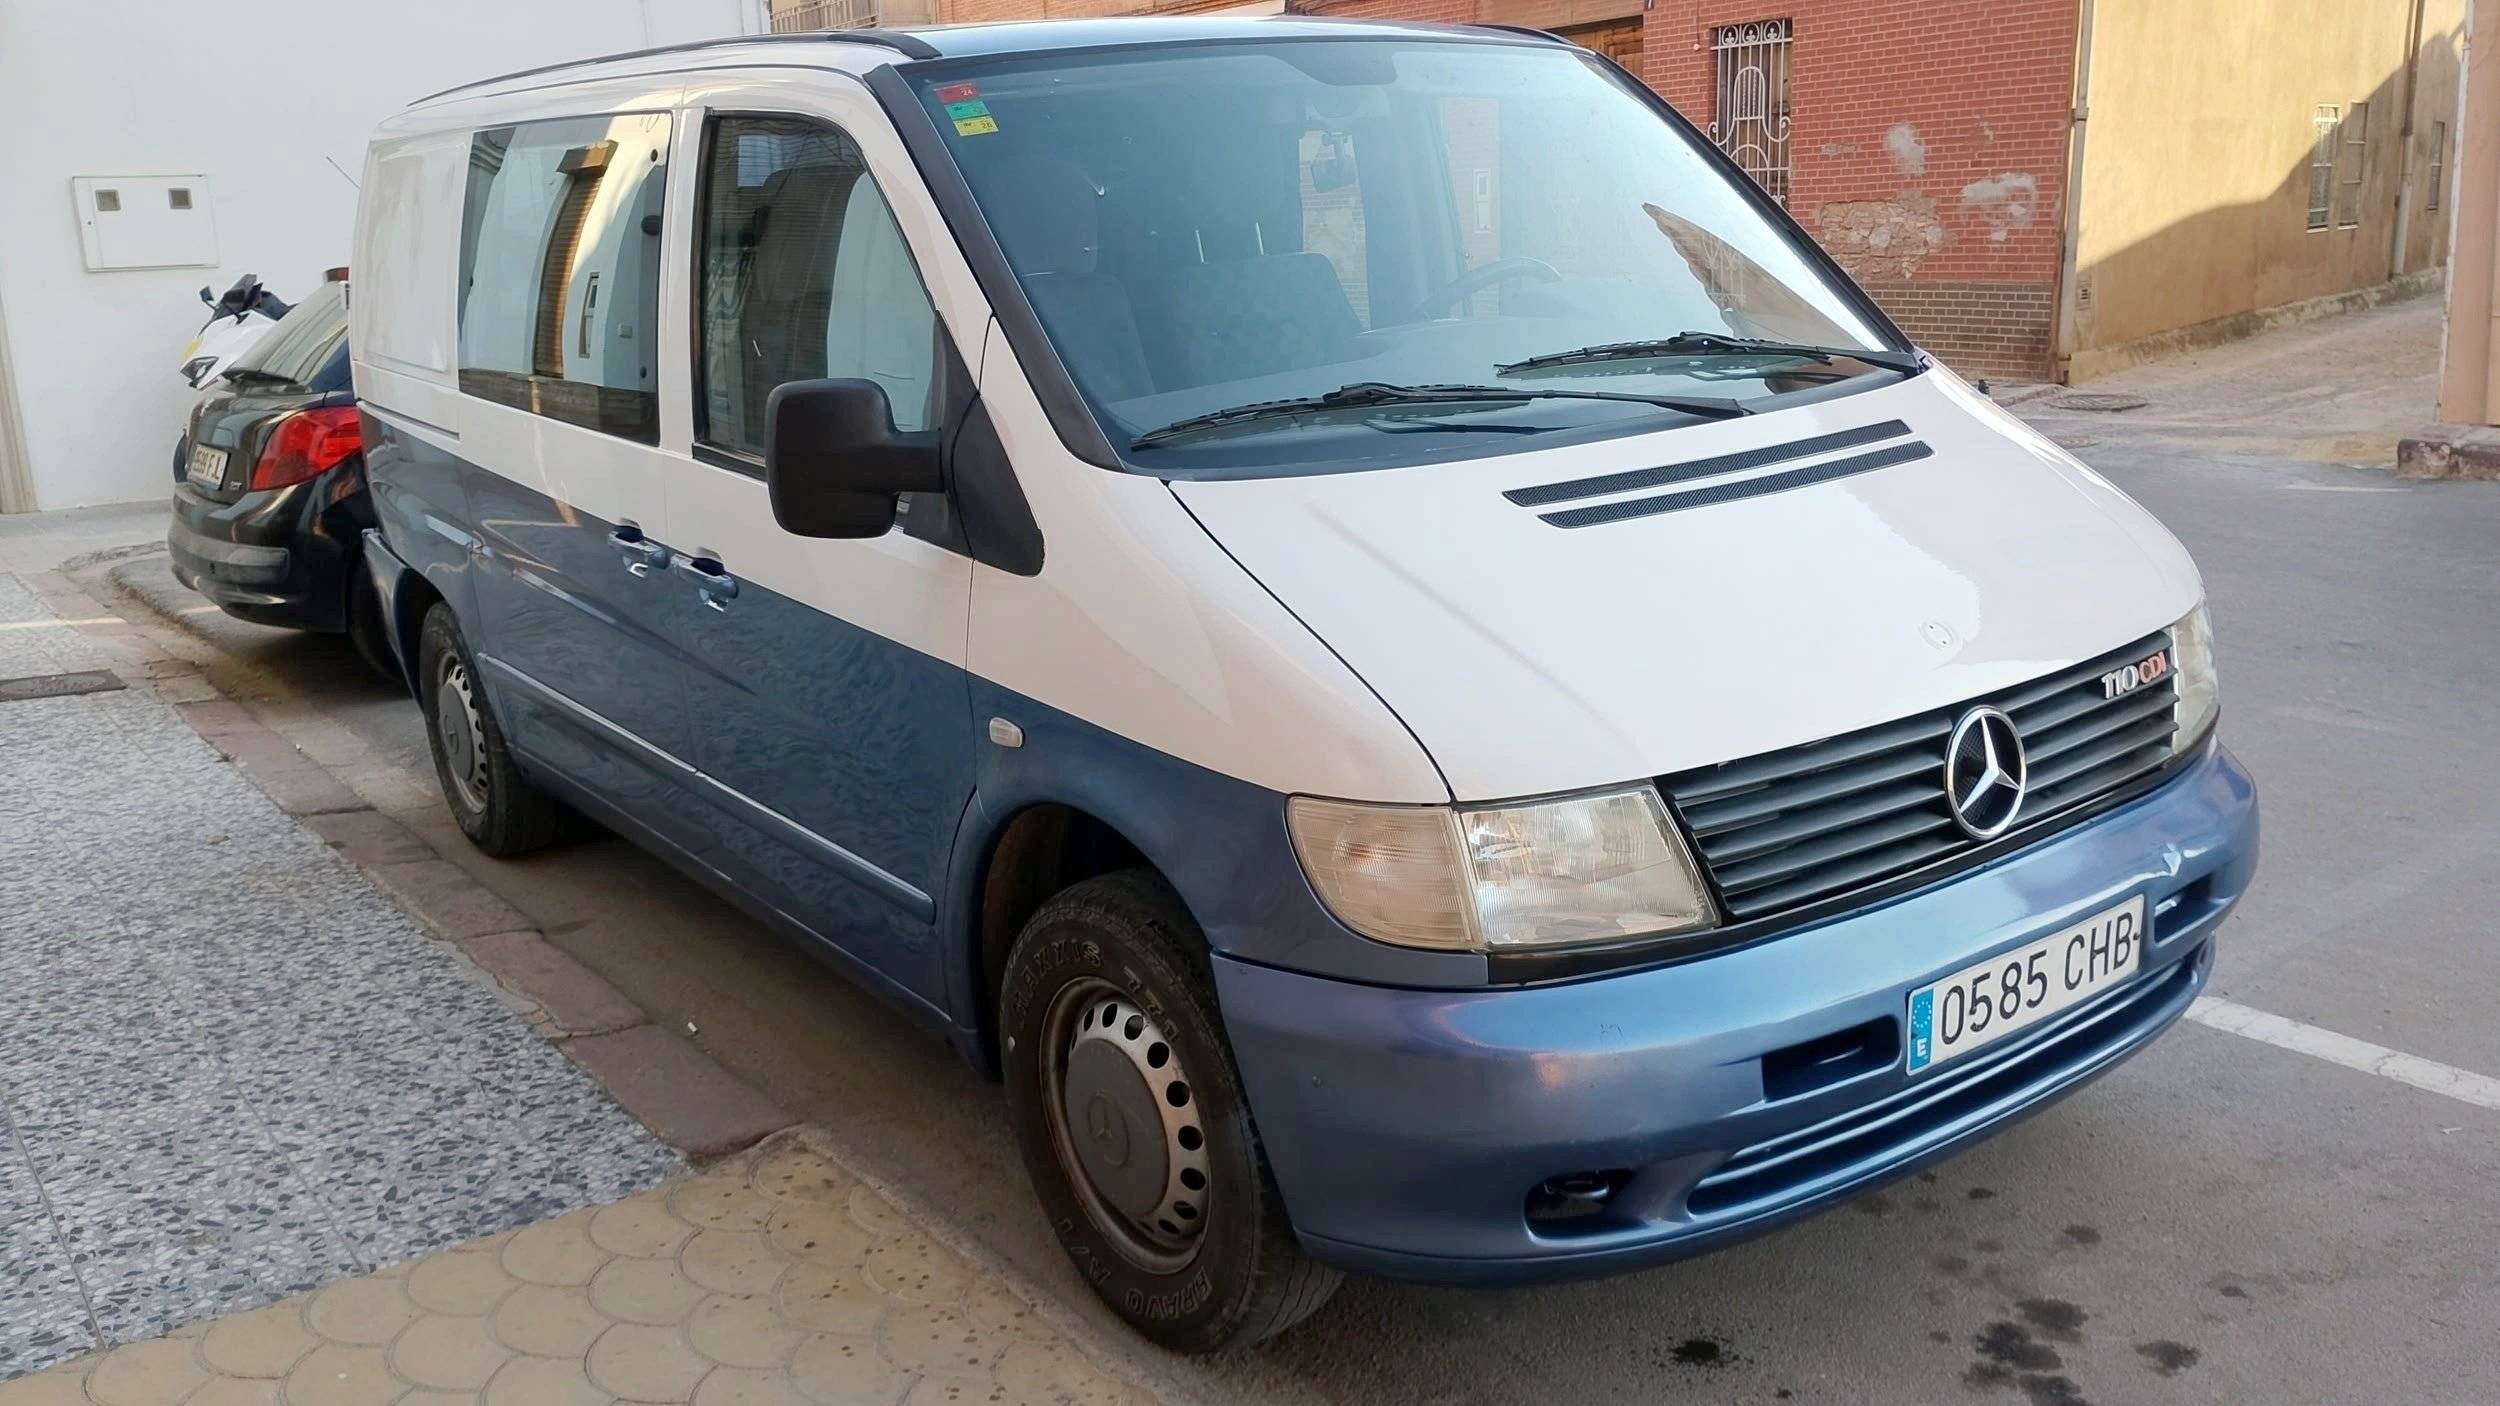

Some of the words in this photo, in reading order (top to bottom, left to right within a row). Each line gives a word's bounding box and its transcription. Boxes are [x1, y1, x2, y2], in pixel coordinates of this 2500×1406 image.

[2101, 664, 2139, 699] 110
[2139, 651, 2167, 684] CDI
[1917, 1038, 1927, 1057] E
[1941, 949, 2048, 1045] 0585
[2064, 912, 2133, 991] CHB
[1124, 1267, 1215, 1320] BRAVO
